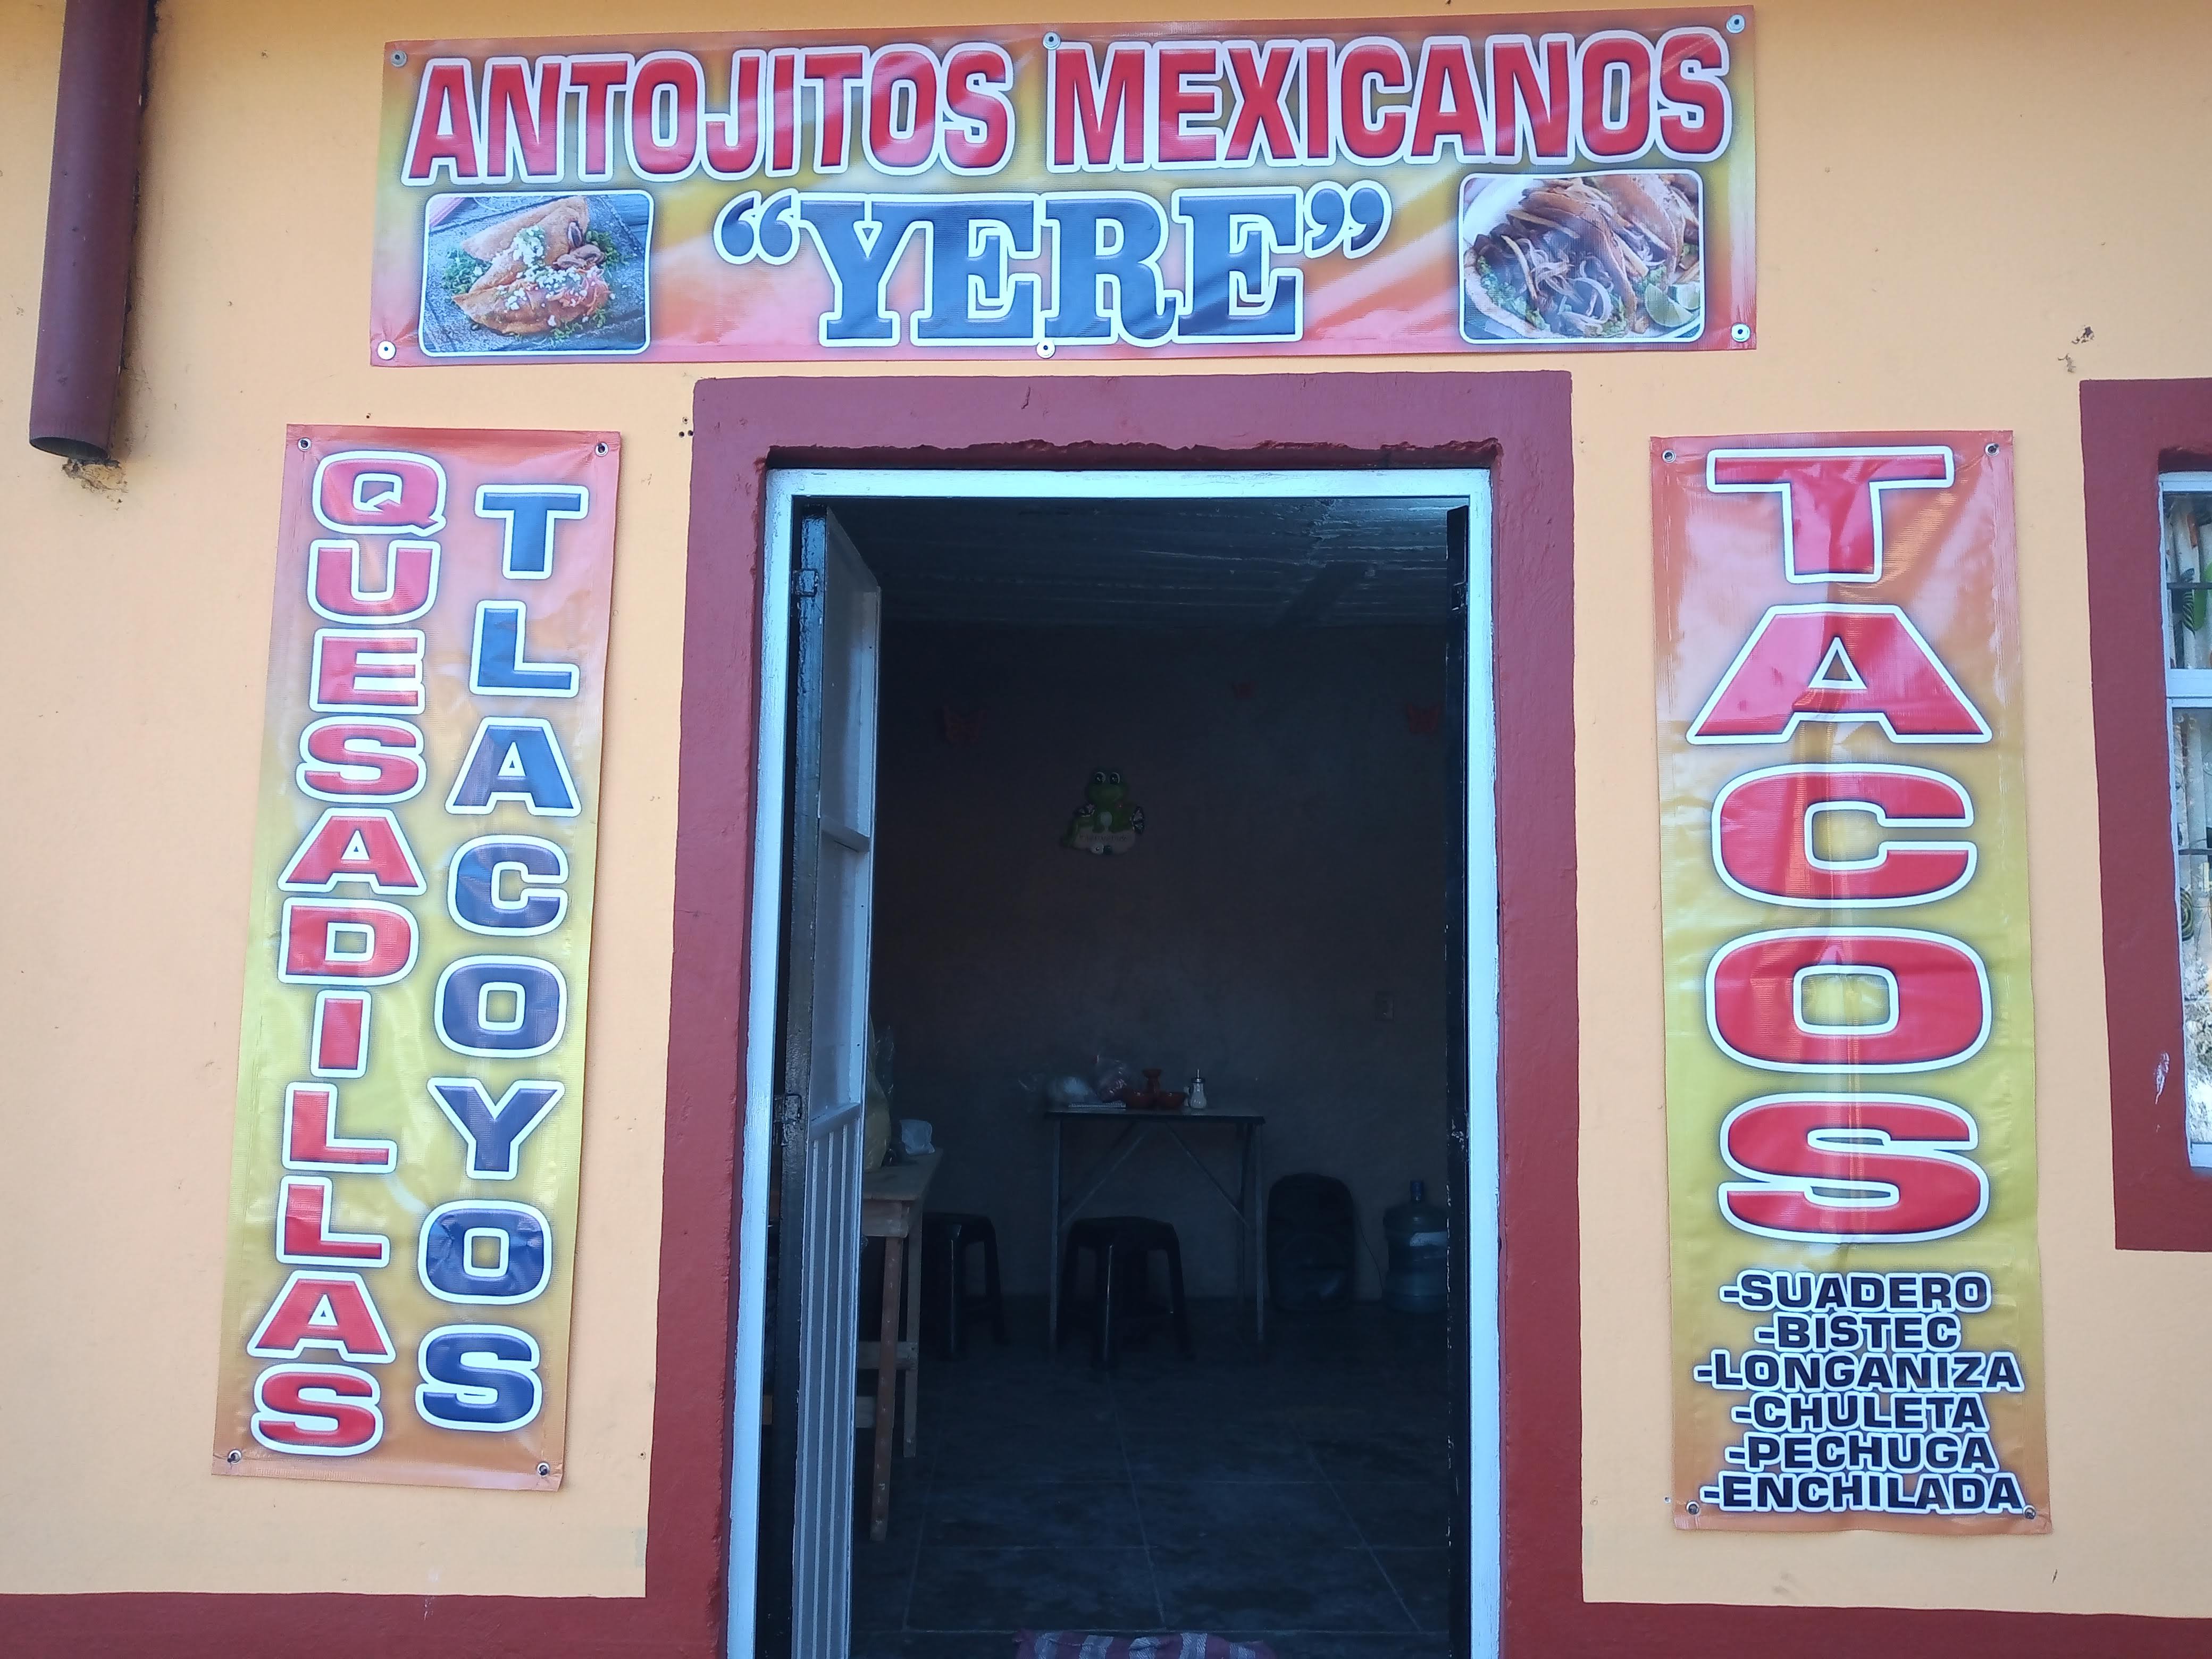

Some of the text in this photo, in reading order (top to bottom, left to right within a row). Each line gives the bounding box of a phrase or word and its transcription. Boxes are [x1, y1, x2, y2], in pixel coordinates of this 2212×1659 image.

[400, 26, 1729, 185] ANTOJITOS MEXICANOS
[1686, 446, 1993, 1243] TACOS
[247, 450, 447, 1456] QUESADILLAS
[415, 484, 589, 1432] TLACOYOS
[1719, 1269, 1991, 1313] -SUADERO
[1754, 1312, 1962, 1352] -BISTEC
[1694, 1350, 2025, 1392] -LONGANIZA
[1731, 1392, 1990, 1434] -CHULETA
[1725, 1431, 2000, 1473] -PECHUGA
[1699, 1471, 2026, 1513] -ENCHILADA
